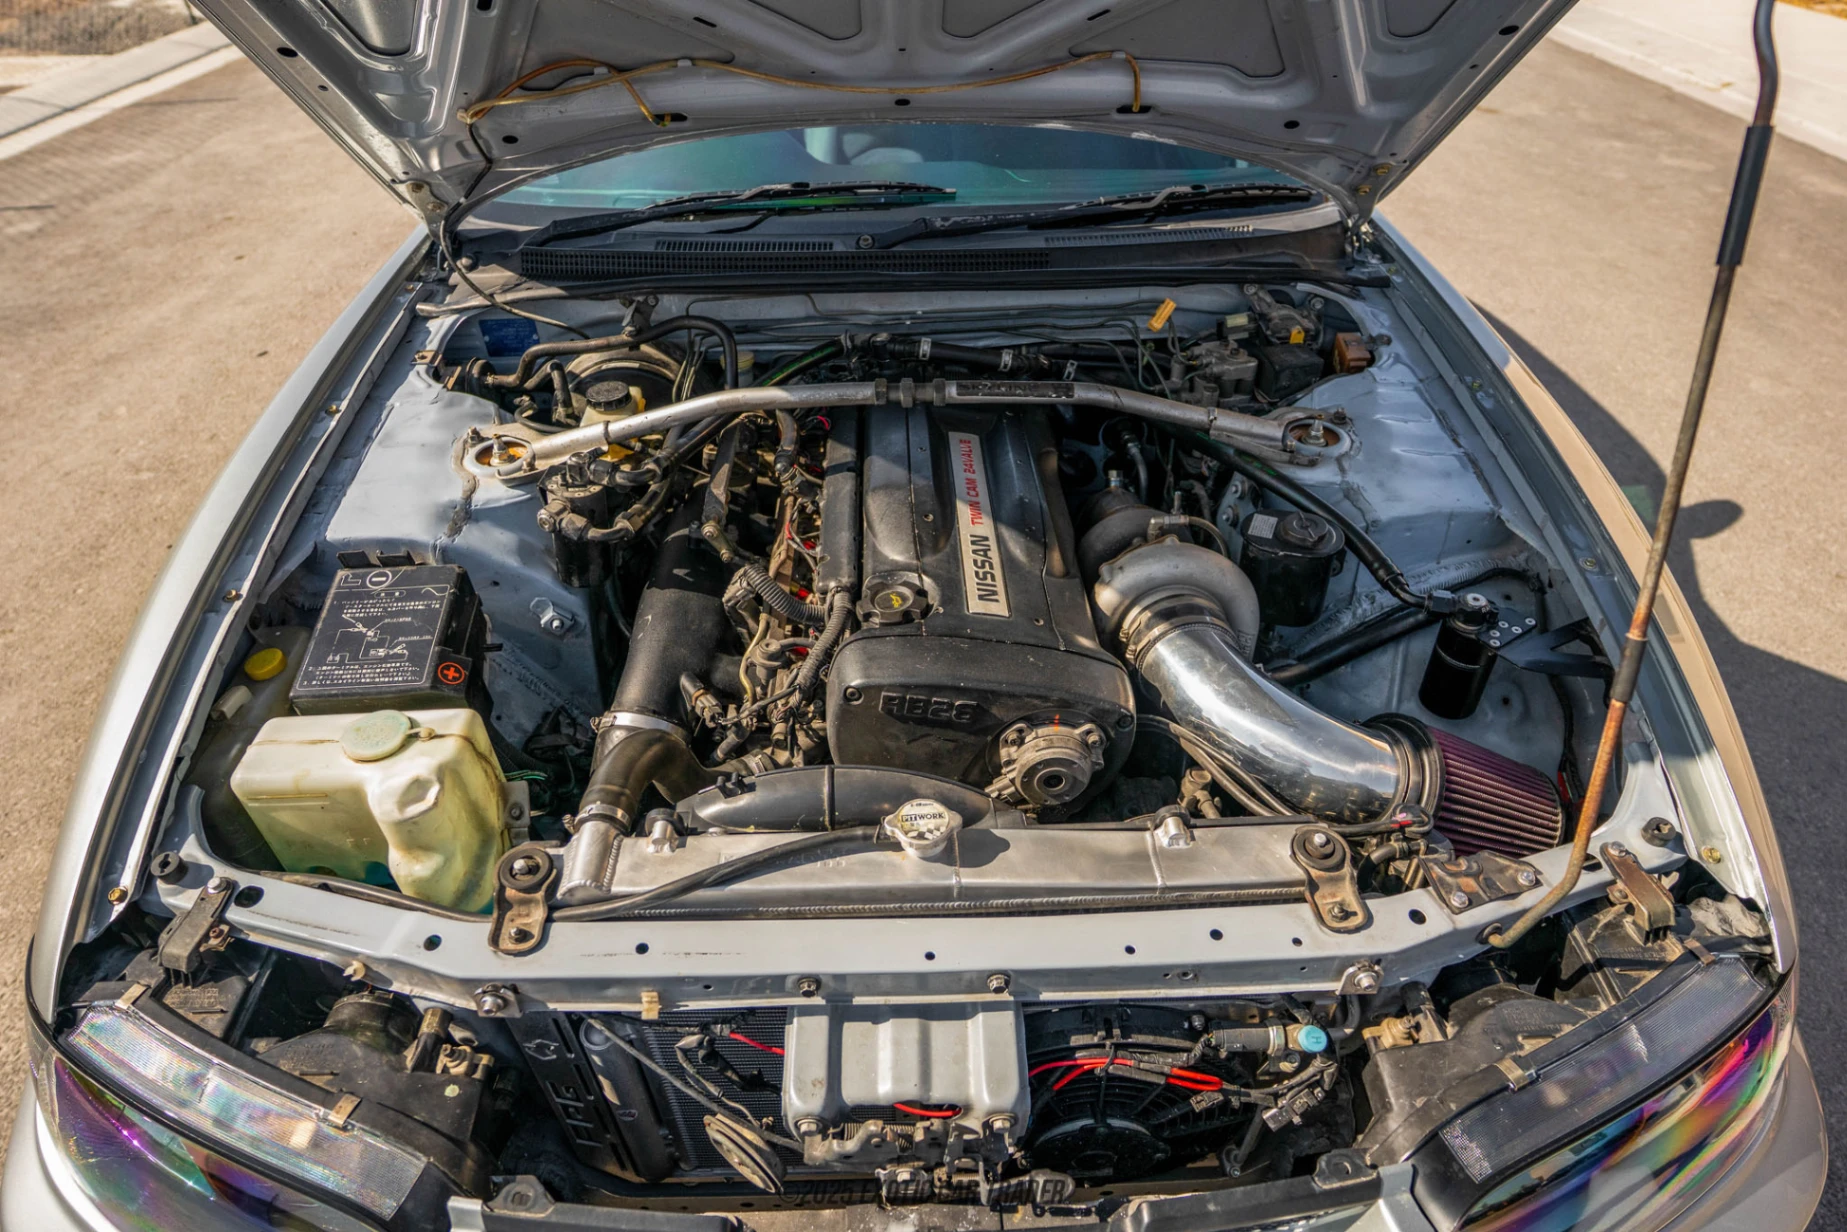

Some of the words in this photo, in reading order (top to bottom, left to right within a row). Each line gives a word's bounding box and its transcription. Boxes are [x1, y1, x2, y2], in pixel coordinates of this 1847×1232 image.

[959, 439, 977, 475] 24VALVE
[964, 478, 981, 501] CAM
[968, 501, 984, 526] TWIN
[969, 534, 1000, 603] NISSAN
